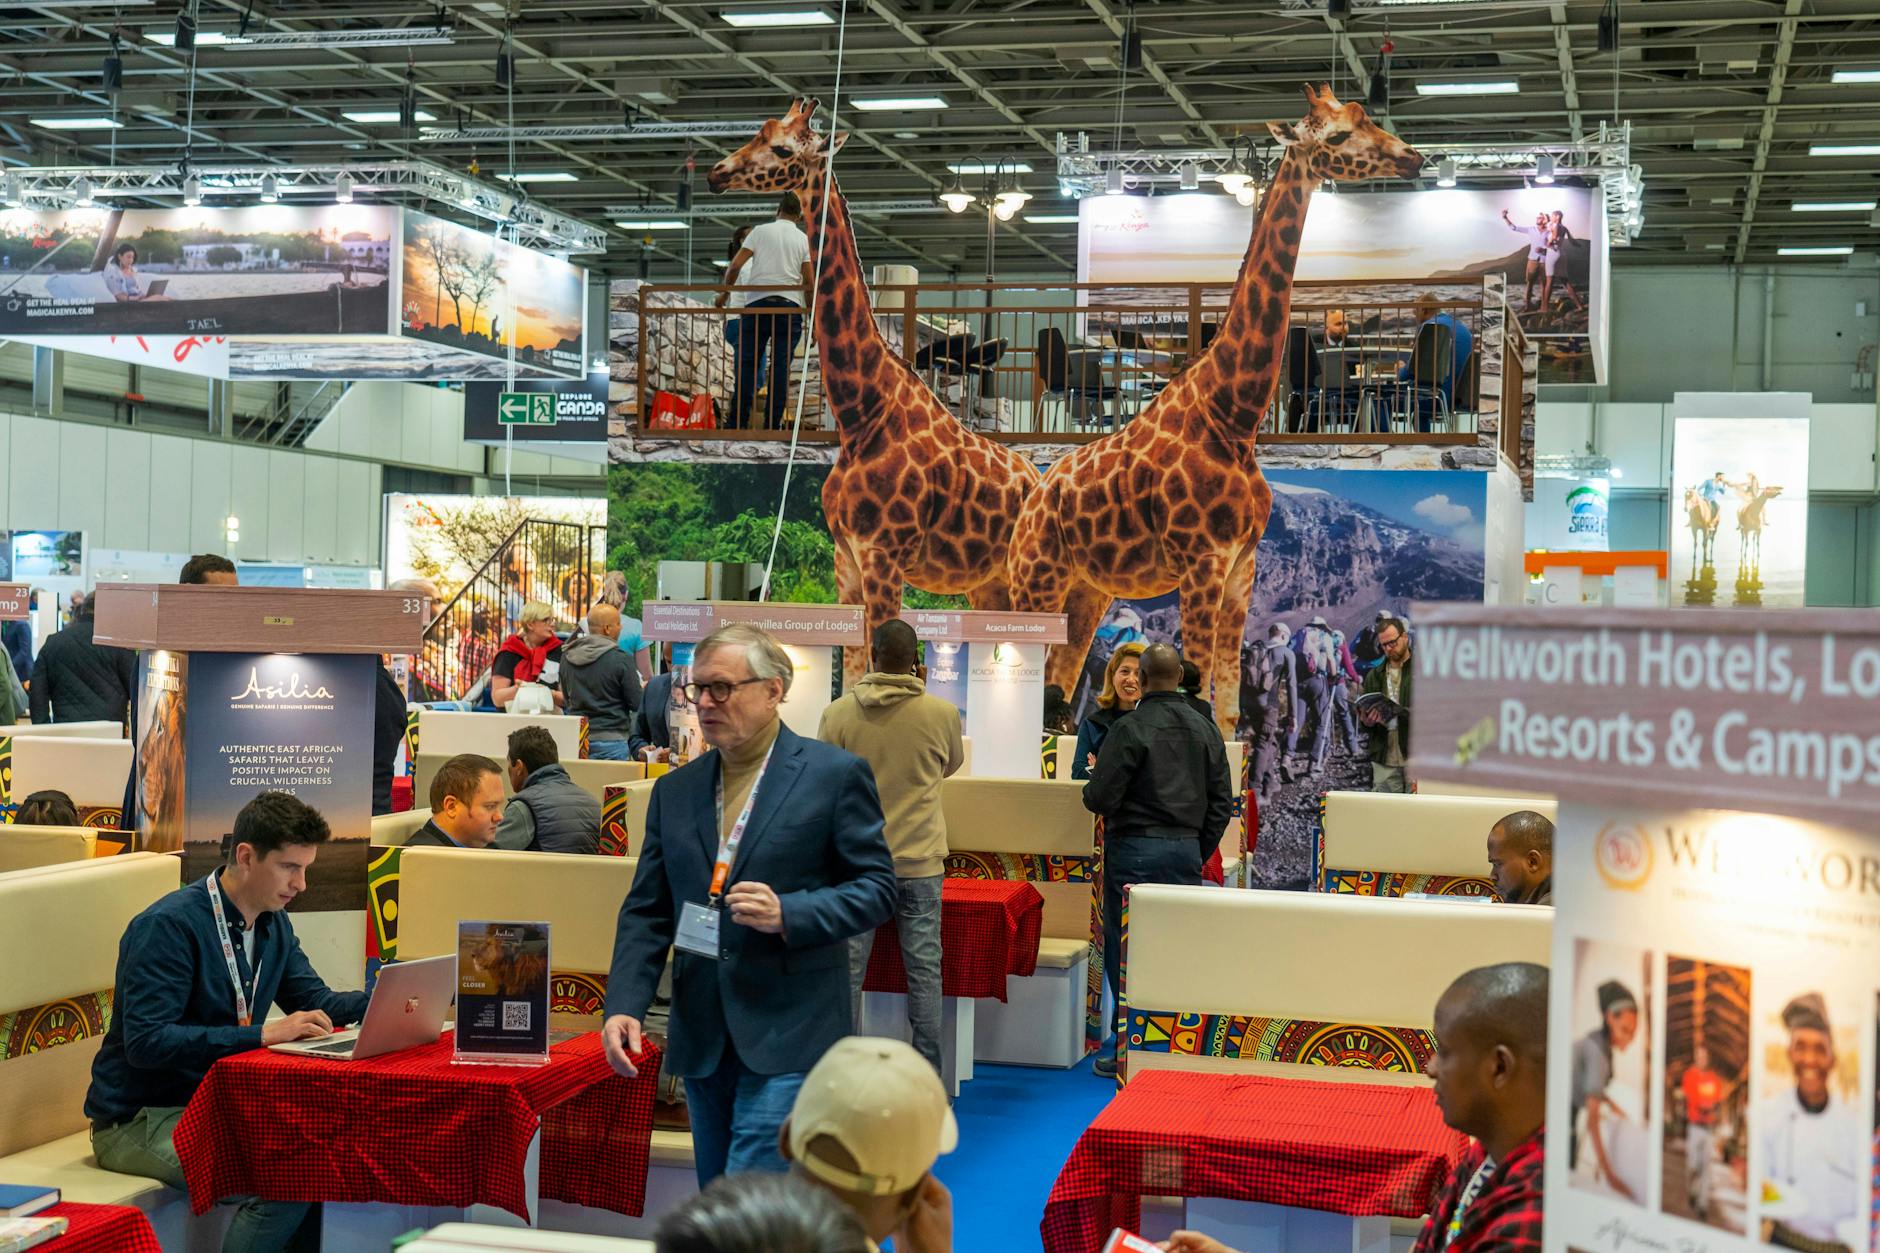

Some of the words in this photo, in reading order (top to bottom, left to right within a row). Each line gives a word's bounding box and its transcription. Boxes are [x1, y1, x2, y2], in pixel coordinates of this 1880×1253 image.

[26, 306, 95, 317] MAGICALKENYA.COM
[557, 401, 606, 415] GANDA
[15, 588, 28, 598] 23
[0, 600, 19, 613] mp
[402, 599, 421, 614] 33
[653, 605, 672, 615] Essential
[672, 605, 700, 616] Destinations
[705, 605, 713, 616] 22
[852, 610, 863, 620] 21
[670, 620, 690, 632] Holidays
[720, 619, 783, 630] Boinvillea
[784, 620, 813, 632] Group
[814, 619, 824, 630] of
[825, 620, 858, 632] Lodges
[985, 624, 1007, 632] Acacia
[1007, 624, 1025, 632] Farm
[1025, 625, 1047, 633] Lodge
[1417, 624, 1627, 687] Wellworth
[1637, 629, 1806, 703] Hotels,
[1819, 634, 1880, 698] Lo
[231, 666, 334, 700] Asilia
[219, 745, 275, 753] AUTHENTIC
[277, 745, 301, 753] EAST
[302, 745, 343, 753] AFRICAN
[1499, 700, 1655, 767] Resorts
[1664, 707, 1702, 770] &
[1711, 711, 1880, 799] Camps
[228, 756, 267, 764] SAFARIS
[269, 756, 294, 764] THAT
[296, 756, 325, 764] LEAVE
[326, 756, 334, 764] A
[232, 766, 276, 775] POSITIVE
[278, 766, 313, 775] IMPACT
[315, 766, 330, 774] ON
[229, 777, 271, 786] CRUCIAL
[273, 777, 332, 785] WILDERNESS
